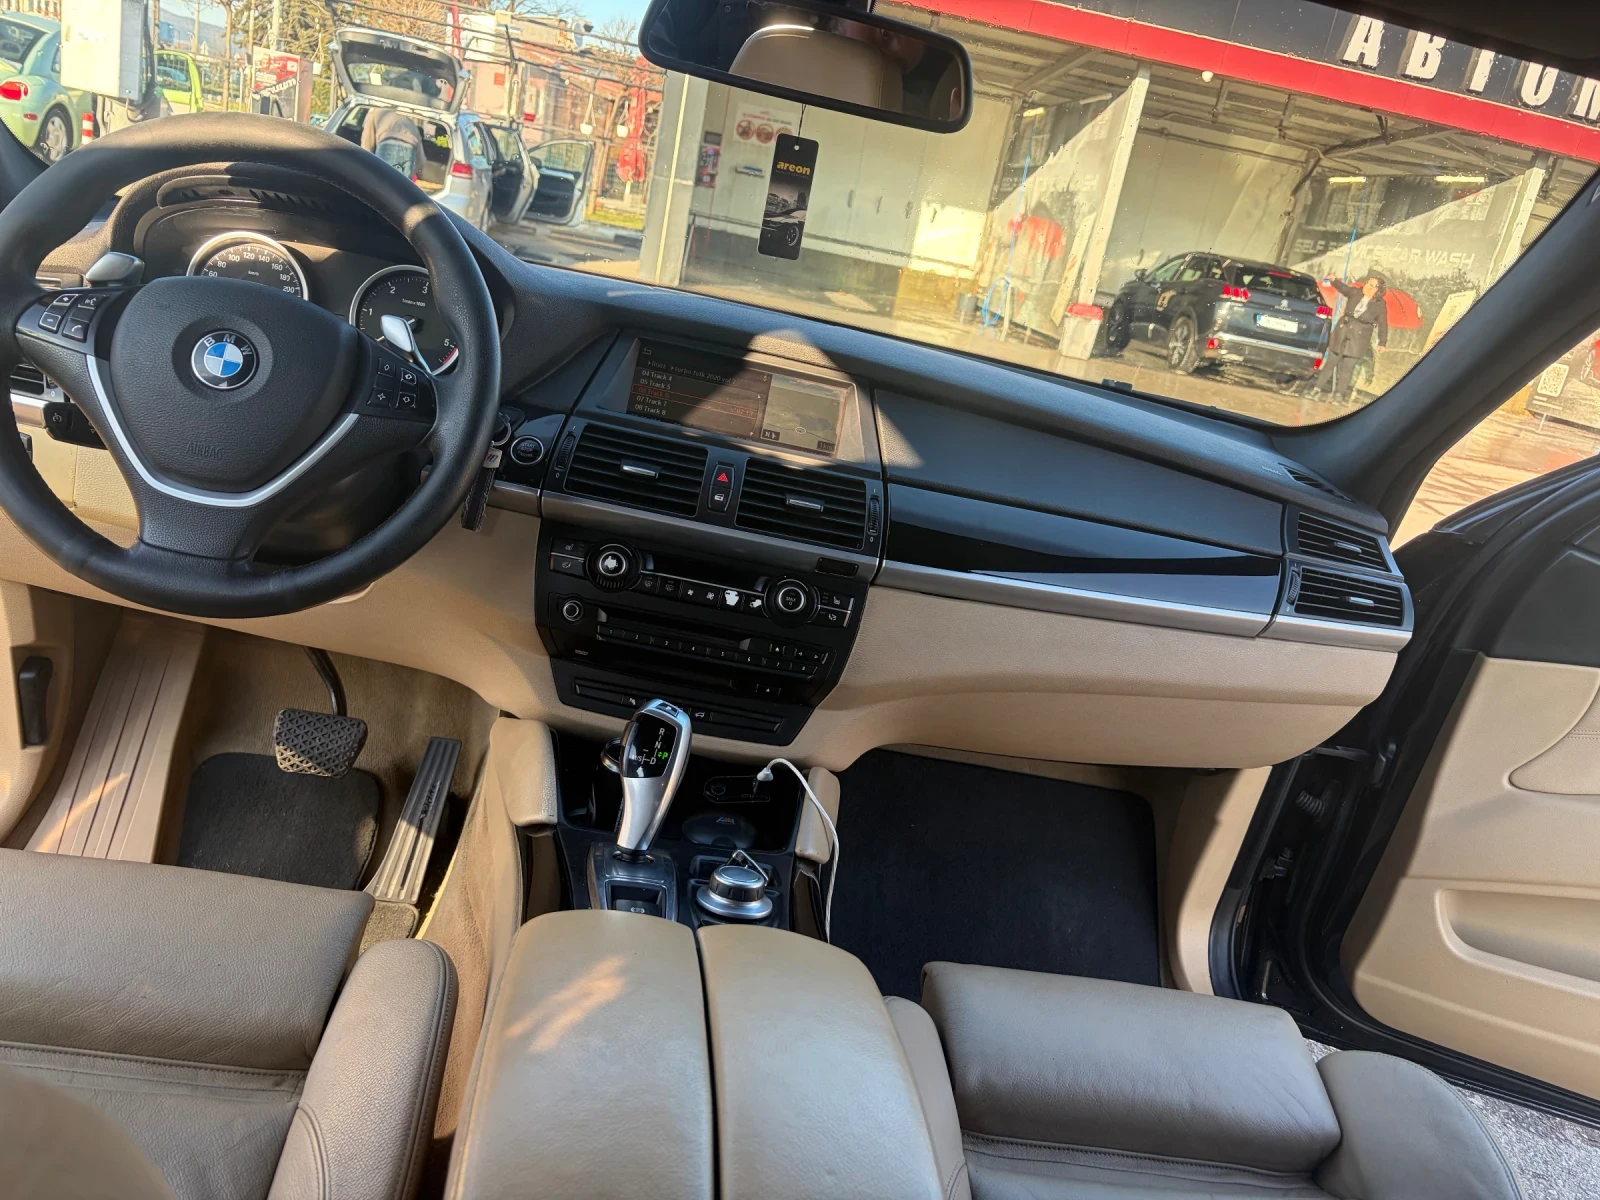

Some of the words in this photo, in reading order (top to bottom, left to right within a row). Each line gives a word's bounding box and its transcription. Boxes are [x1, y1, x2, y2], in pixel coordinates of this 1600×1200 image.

[777, 161, 811, 176] areon
[228, 254, 240, 262] 100
[243, 251, 255, 260] 120
[258, 254, 270, 263] 140
[1388, 246, 1421, 264] CAR
[1425, 250, 1475, 269] WASH
[217, 260, 227, 268] 80
[271, 263, 283, 271] 160
[390, 286, 396, 294] 2
[422, 286, 428, 294] 3
[203, 333, 252, 356] BMW
[443, 338, 449, 346] 5
[651, 360, 666, 369] Root
[674, 366, 691, 375] turbo
[692, 370, 705, 378] folk
[706, 372, 721, 381] 2020
[651, 370, 667, 381] Track
[649, 379, 665, 389] Track
[647, 388, 664, 397] Track
[645, 396, 661, 406] Track
[644, 405, 660, 415] Track
[185, 441, 223, 460] AIRBAG
[659, 728, 665, 736] R
[655, 741, 661, 749] N
